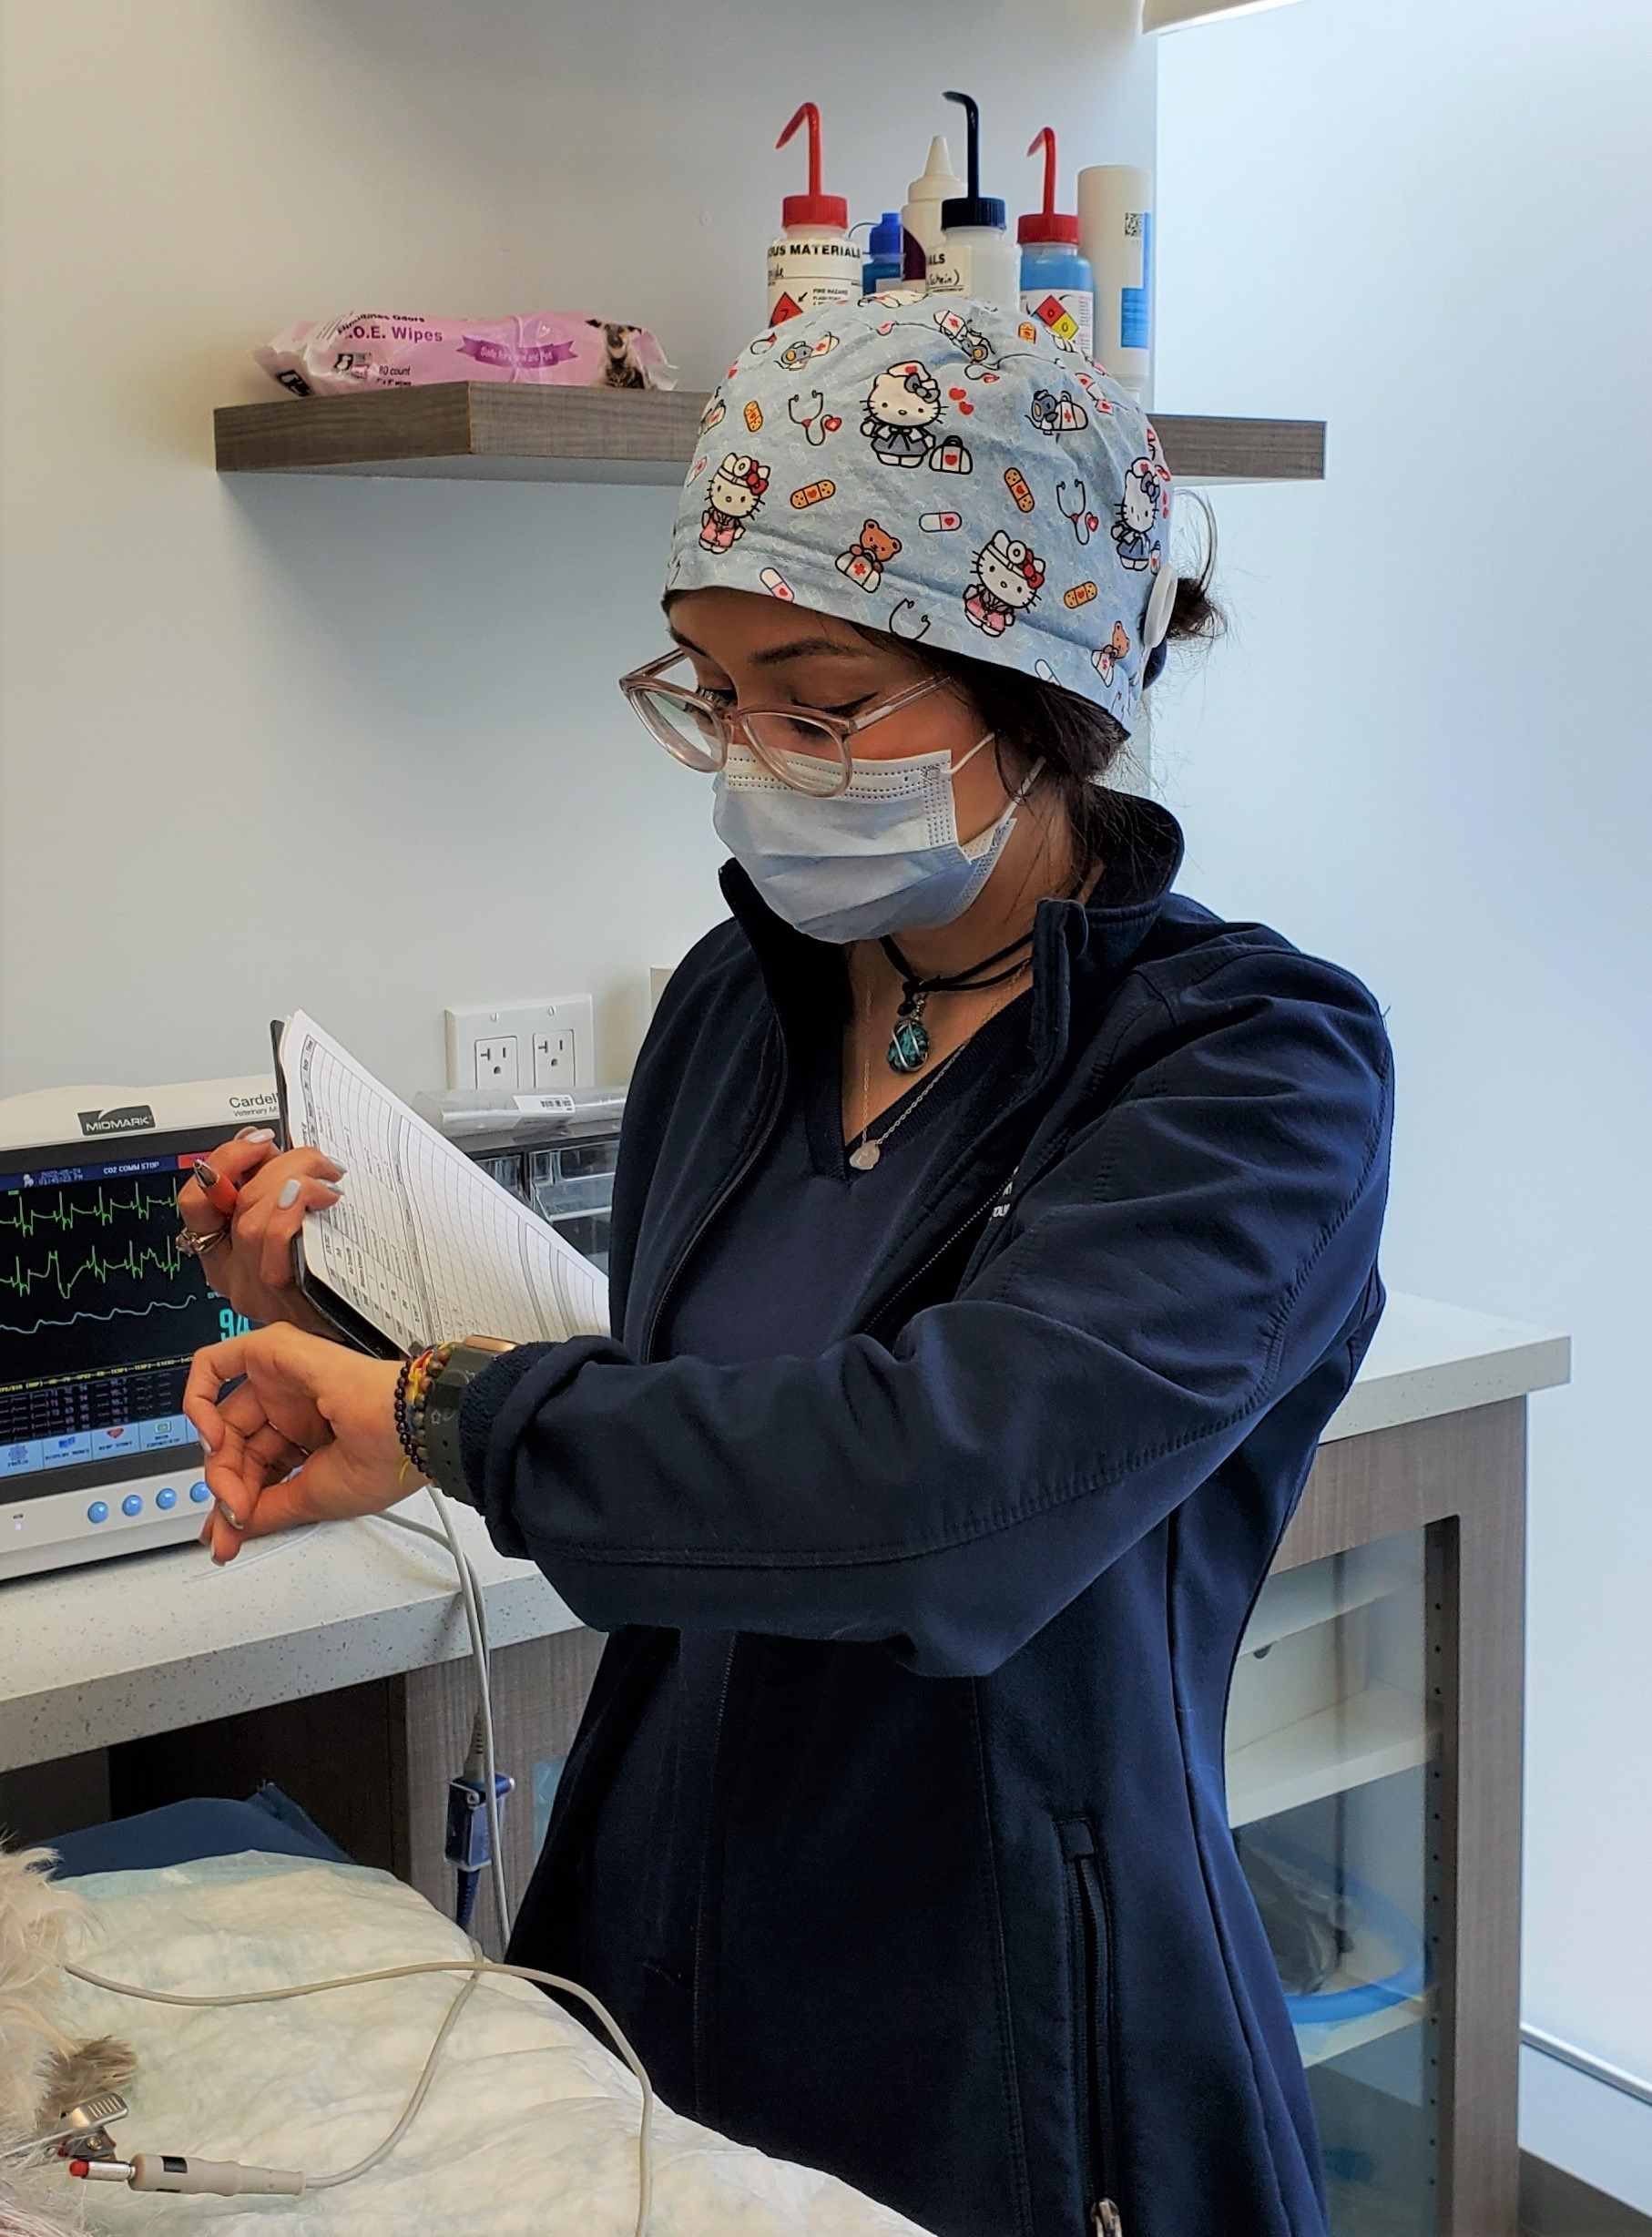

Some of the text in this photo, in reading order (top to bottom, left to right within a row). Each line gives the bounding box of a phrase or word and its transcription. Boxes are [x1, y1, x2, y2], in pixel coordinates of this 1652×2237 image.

[1047, 309, 1055, 318] 0
[1062, 322, 1068, 332] 0
[392, 326, 443, 343] Wipes
[390, 365, 410, 376] count
[233, 1107, 267, 1118] Veterinary
[85, 1116, 150, 1132] MIDMARK
[103, 1160, 159, 1175] CO2 COMM STOP
